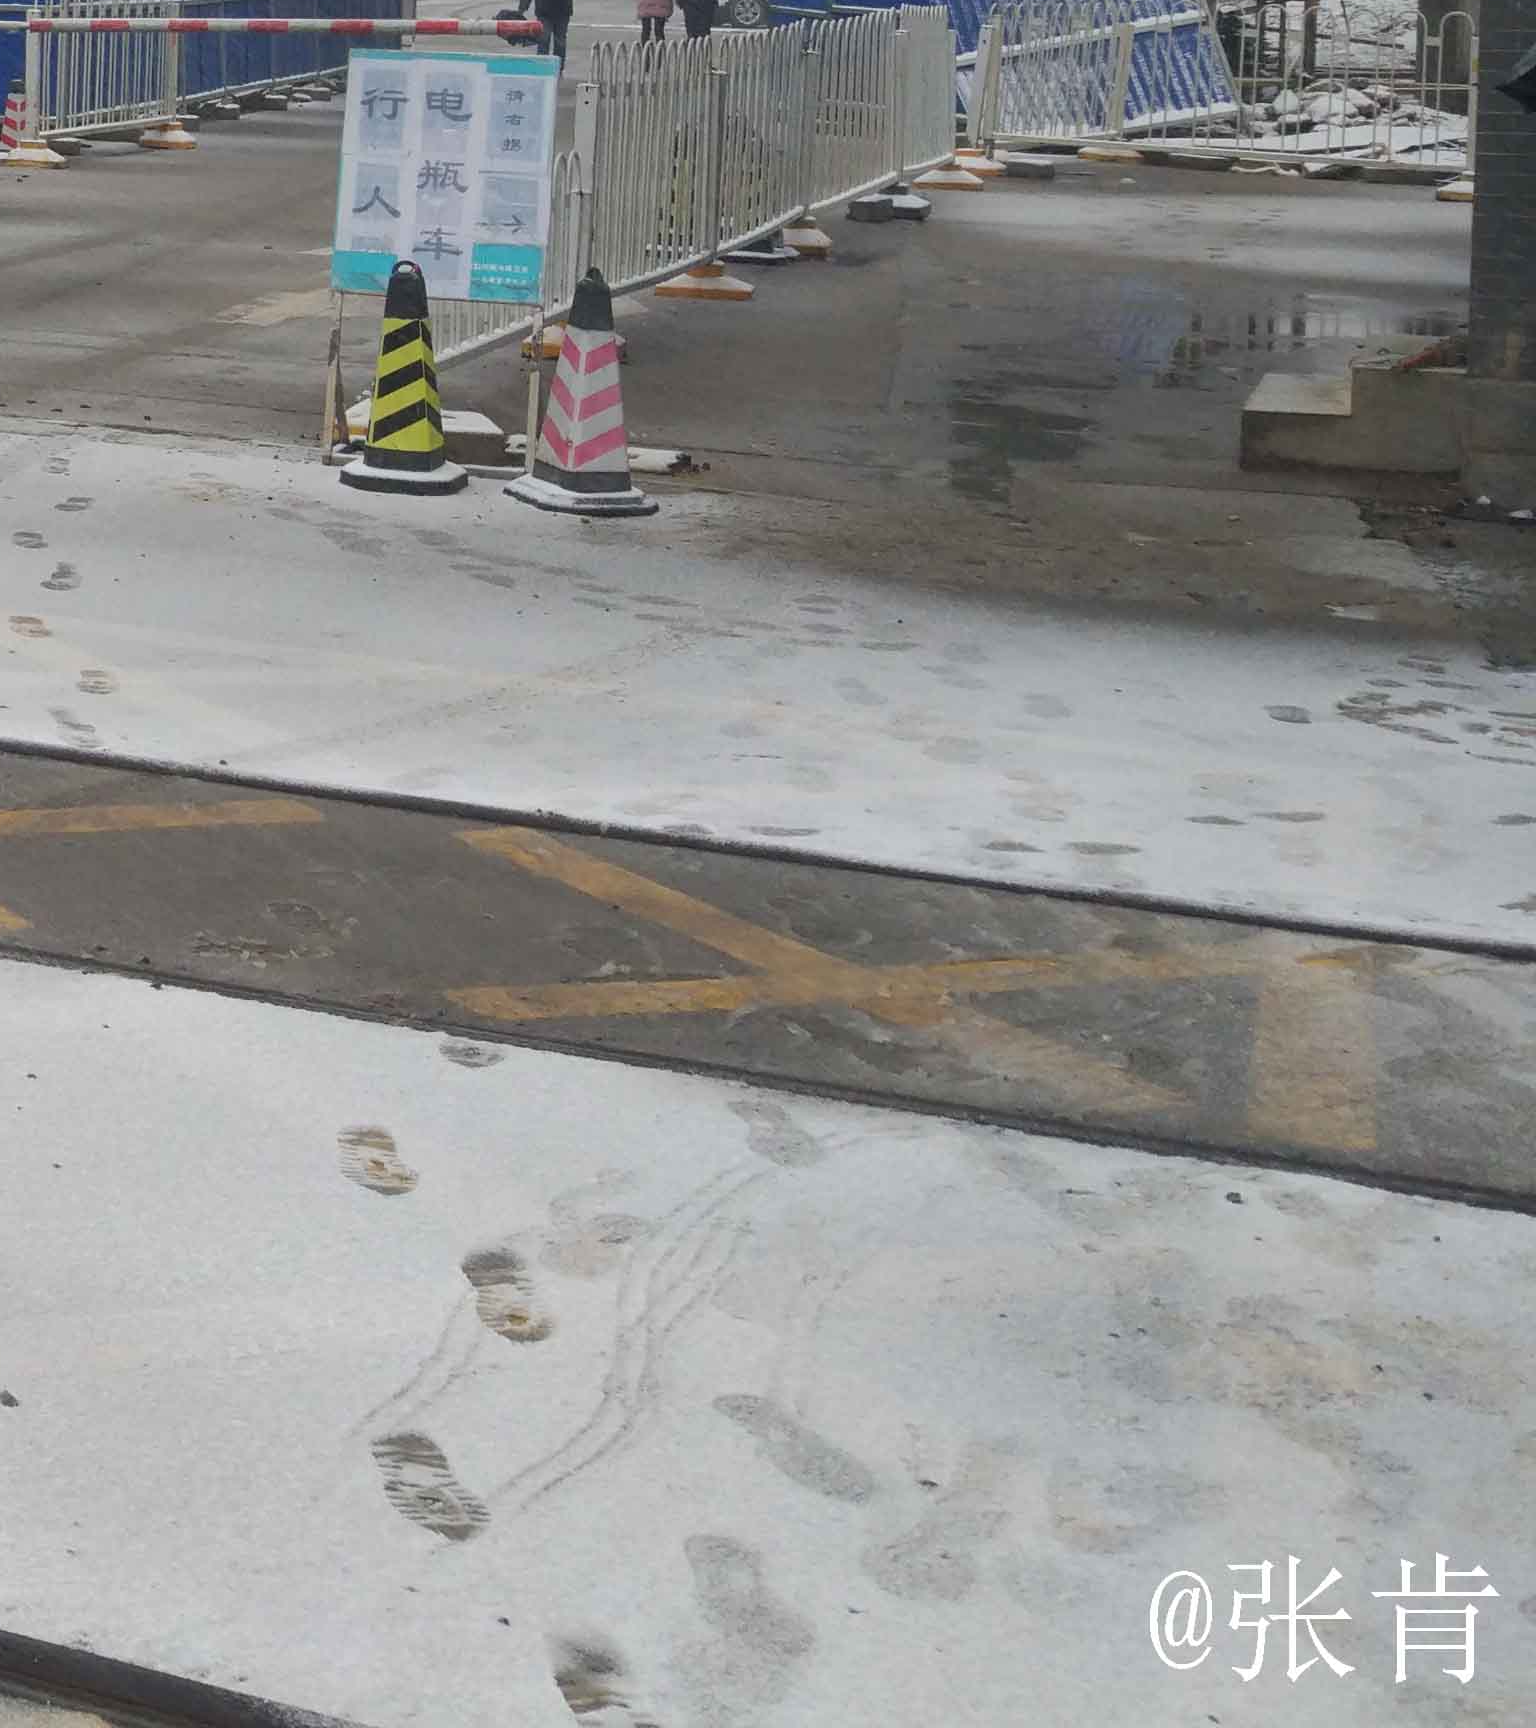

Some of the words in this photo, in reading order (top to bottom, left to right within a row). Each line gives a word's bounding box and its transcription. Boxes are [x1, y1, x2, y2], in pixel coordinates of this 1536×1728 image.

[352, 86, 410, 219] 行人
[412, 87, 473, 261] 电瓶车
